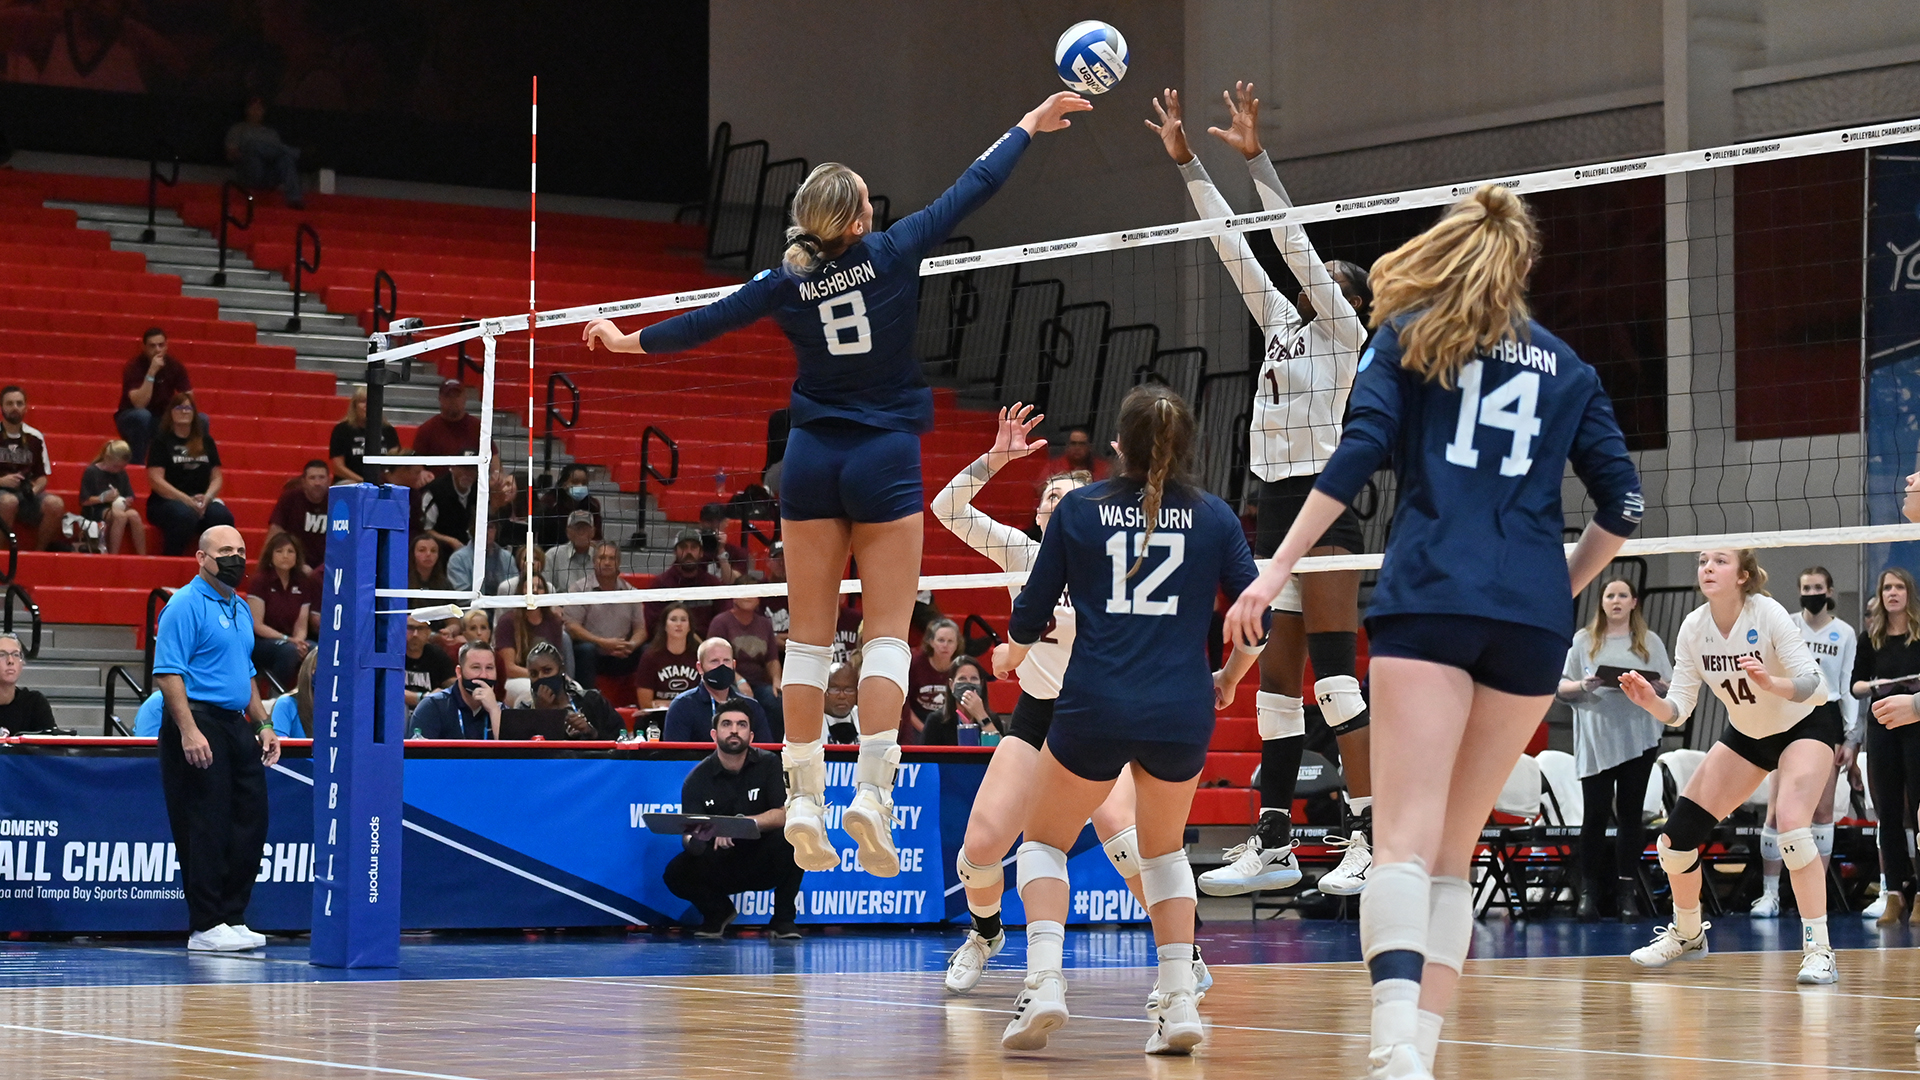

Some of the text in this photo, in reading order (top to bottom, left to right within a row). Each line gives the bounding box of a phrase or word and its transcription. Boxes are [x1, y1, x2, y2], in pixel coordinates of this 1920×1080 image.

[1849, 130, 1881, 142] VOLLEYBALL
[1712, 143, 1781, 160] VOLLEYBALL CHAMPIONSHIP
[1582, 162, 1647, 179] VOLLEYBALL CHAMPIONSHIP
[1342, 196, 1400, 212] VOLLEYBALL CHAMPIONSHIP
[1231, 212, 1287, 227] VOLLEYBALL CHAMPIONSHIP
[1128, 227, 1179, 241] VOLLEYBALL CHAMPIONSHIP
[1028, 241, 1078, 255] VOLLEYBALL CHAMPIONSHIP
[799, 260, 876, 301] WASHBURN
[818, 289, 872, 356] 8
[1484, 339, 1557, 377] HBURN
[1265, 368, 1279, 405] 1
[1445, 359, 1542, 477] 14
[1099, 504, 1193, 529] WASHURN
[332, 519, 350, 533] NCAA
[1105, 531, 1185, 616] 12
[834, 630, 857, 644] AMU
[1813, 643, 1838, 657] TEXAS
[1702, 654, 1727, 672] WEST
[657, 664, 698, 682] WTAMU
[1720, 677, 1757, 705] 14
[325, 568, 343, 916] VOLLEYBALL
[0, 820, 59, 837] OMEN'S
[368, 816, 380, 904] sports imports
[14, 886, 34, 899] and
[36, 886, 70, 901] Tampa
[72, 886, 92, 902] Bay
[93, 886, 128, 901] Sports
[811, 890, 926, 916] UNIVERSITY
